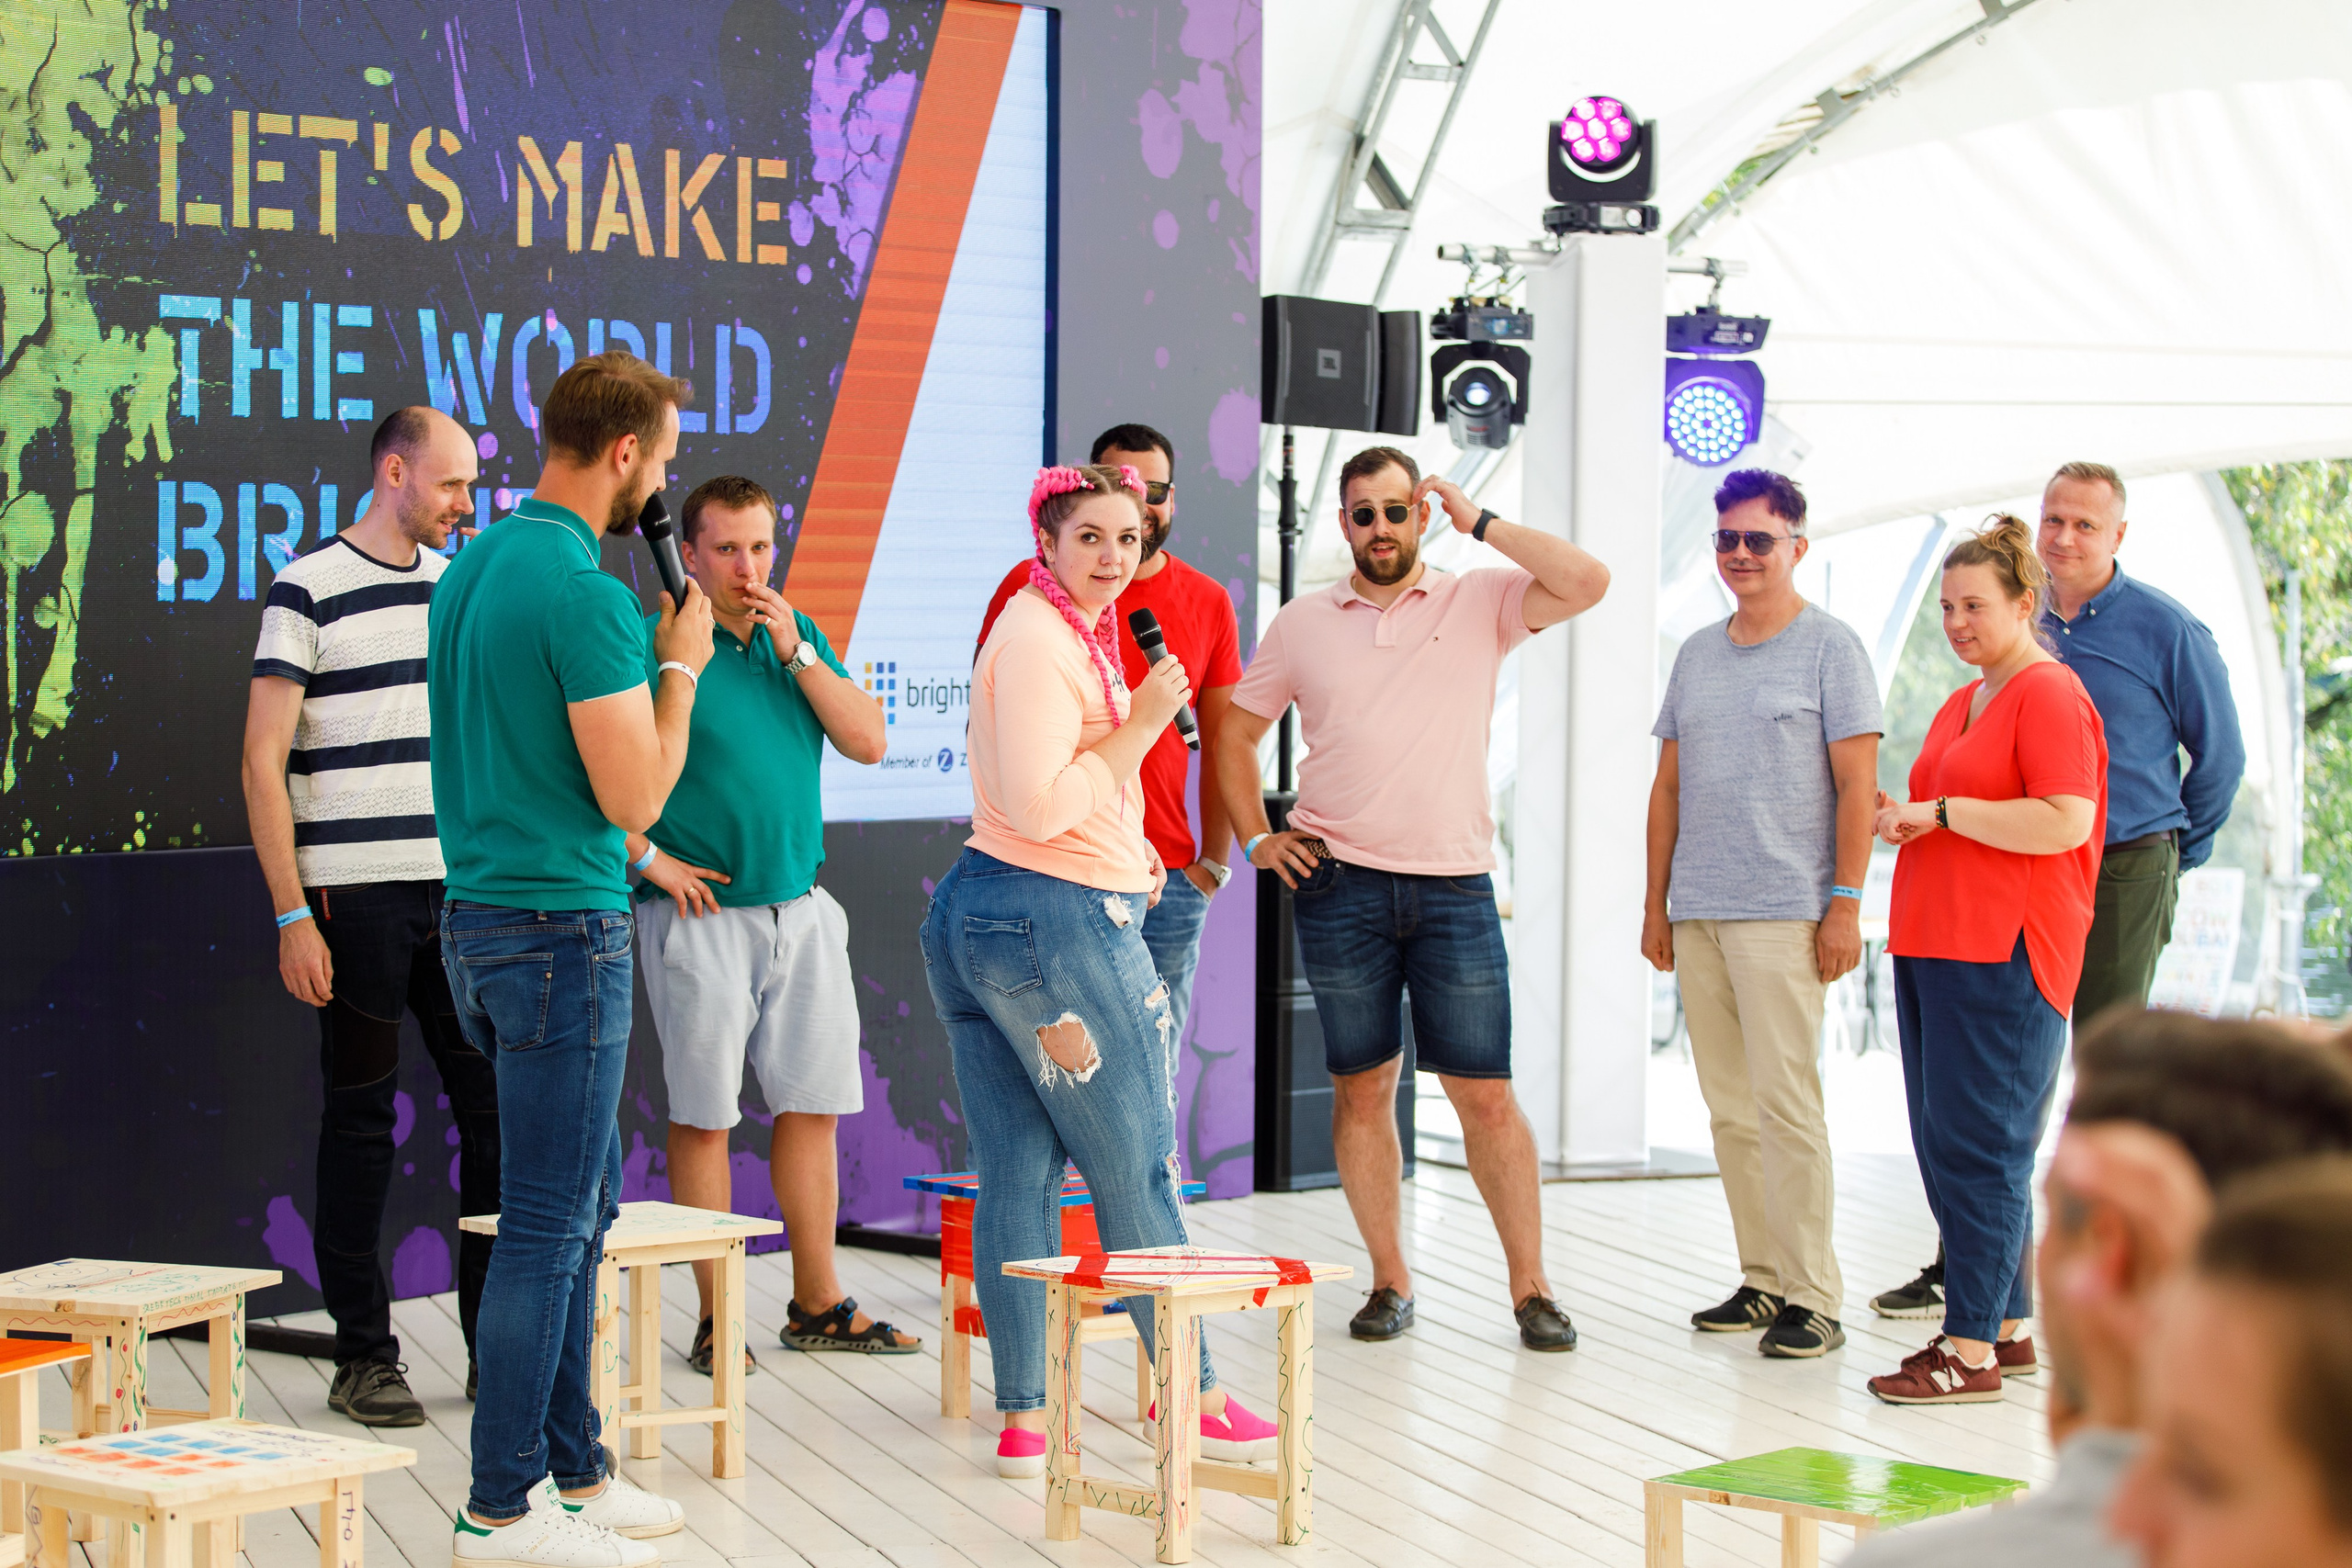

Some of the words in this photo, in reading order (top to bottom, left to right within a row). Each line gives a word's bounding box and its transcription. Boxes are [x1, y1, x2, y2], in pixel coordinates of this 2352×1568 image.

[159, 104, 463, 243] LET'S
[517, 134, 788, 266] MAKE
[159, 295, 373, 423] THE
